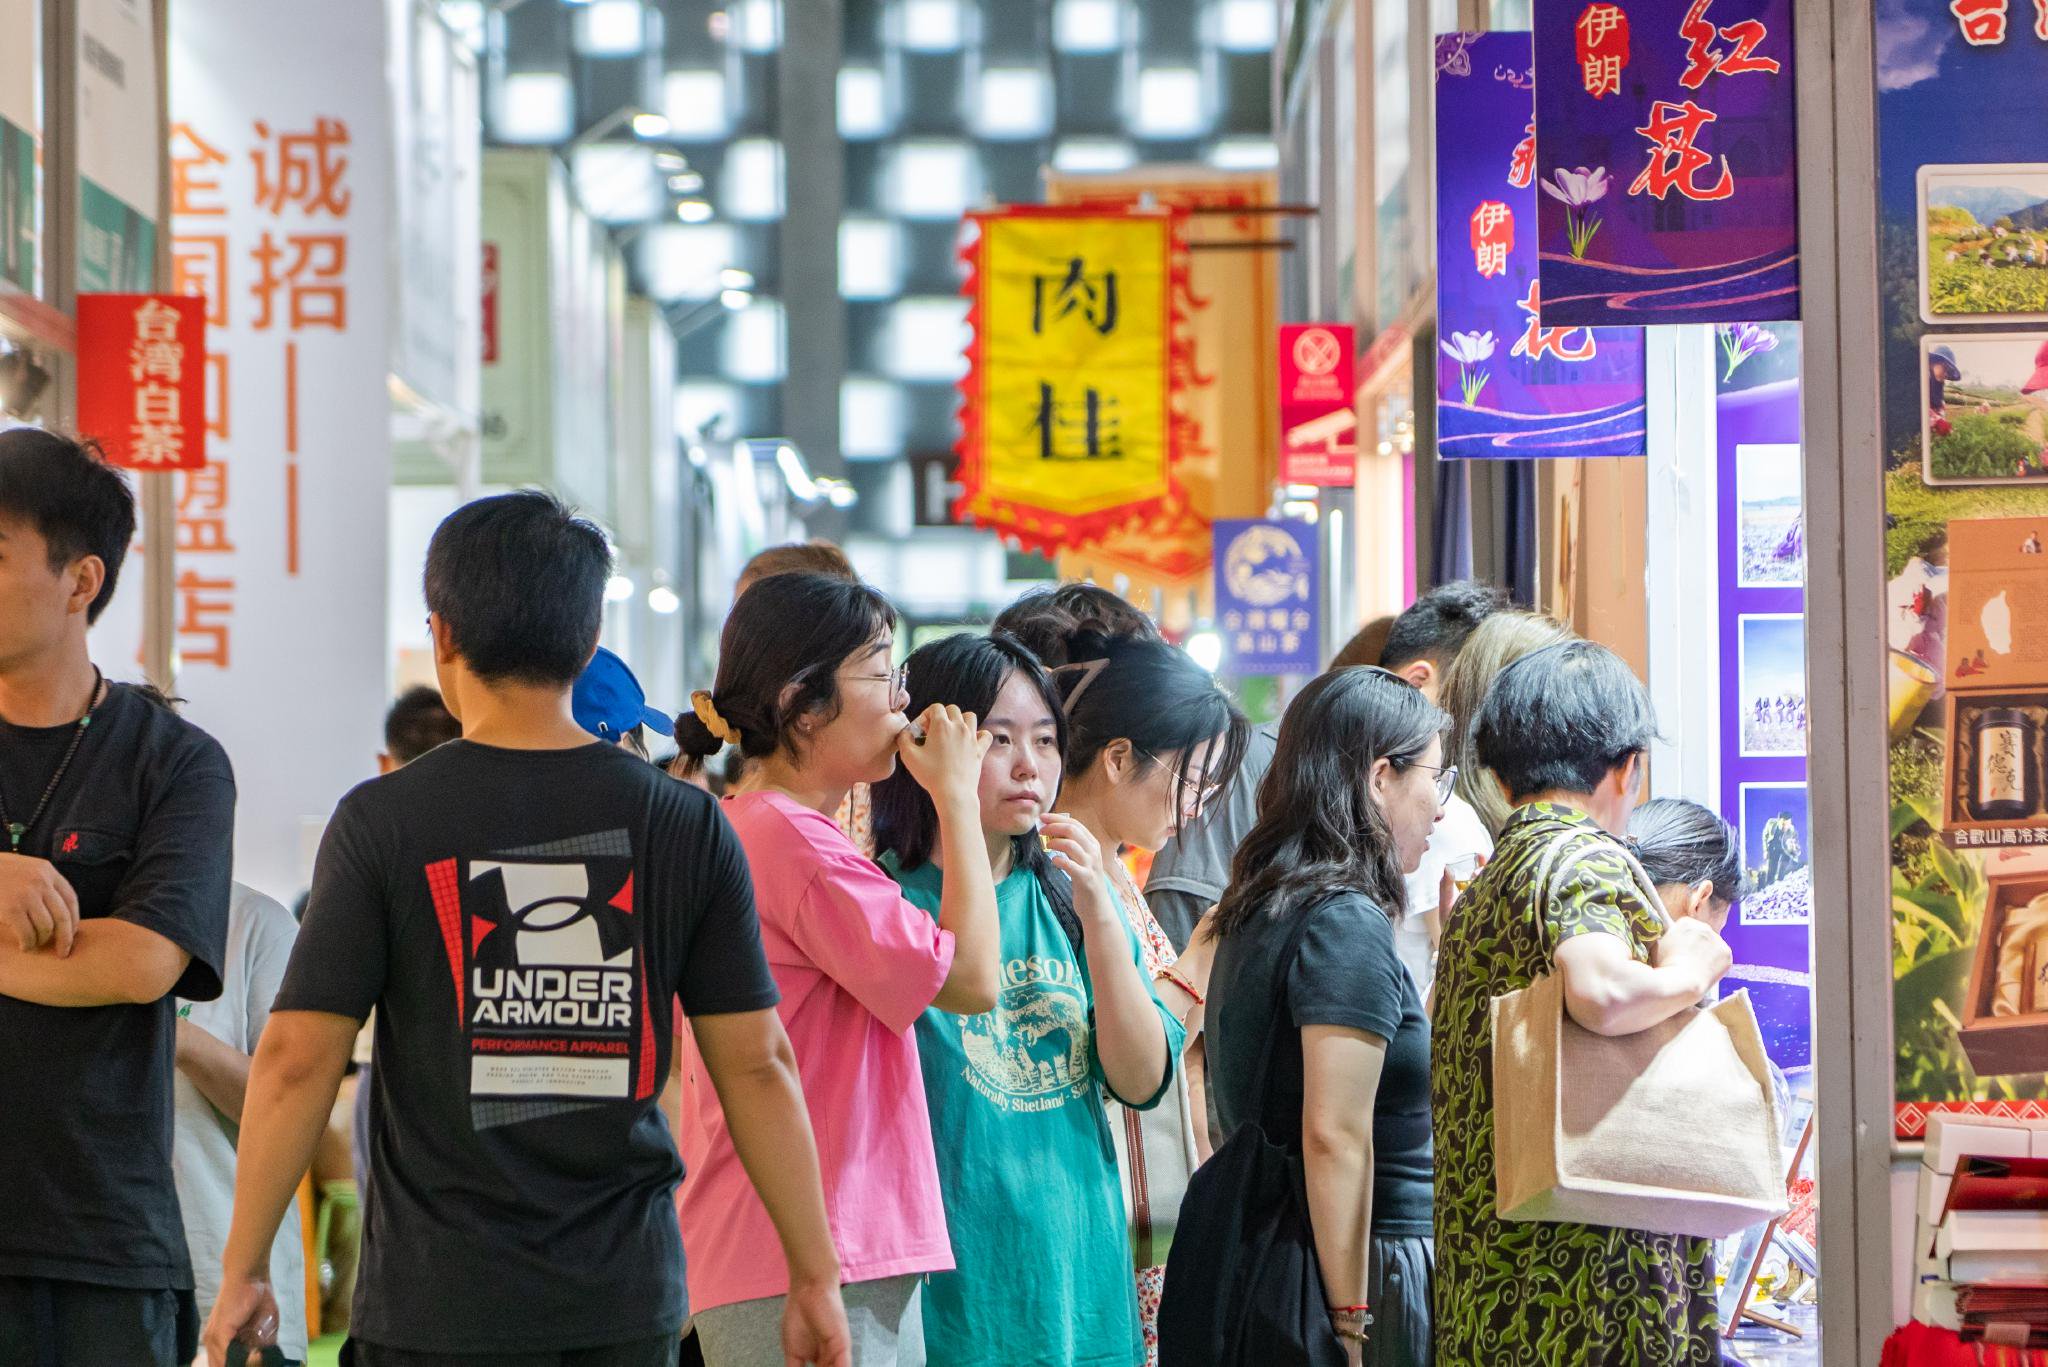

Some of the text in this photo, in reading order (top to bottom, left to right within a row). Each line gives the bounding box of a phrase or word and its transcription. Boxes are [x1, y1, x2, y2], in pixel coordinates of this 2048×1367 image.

[1579, 5, 1626, 96] 伊朗
[1627, 0, 1780, 201] 红花
[1472, 201, 1512, 276] 伊朗
[1023, 258, 1125, 461] 肉桂
[472, 968, 633, 1002] UNDER
[471, 999, 632, 1028] ARMOUR
[471, 1037, 568, 1053] PERFORMANCE
[570, 1041, 630, 1054] APPAREL
[960, 1065, 1010, 1112] Naturally
[1011, 1093, 1065, 1113] Shetland
